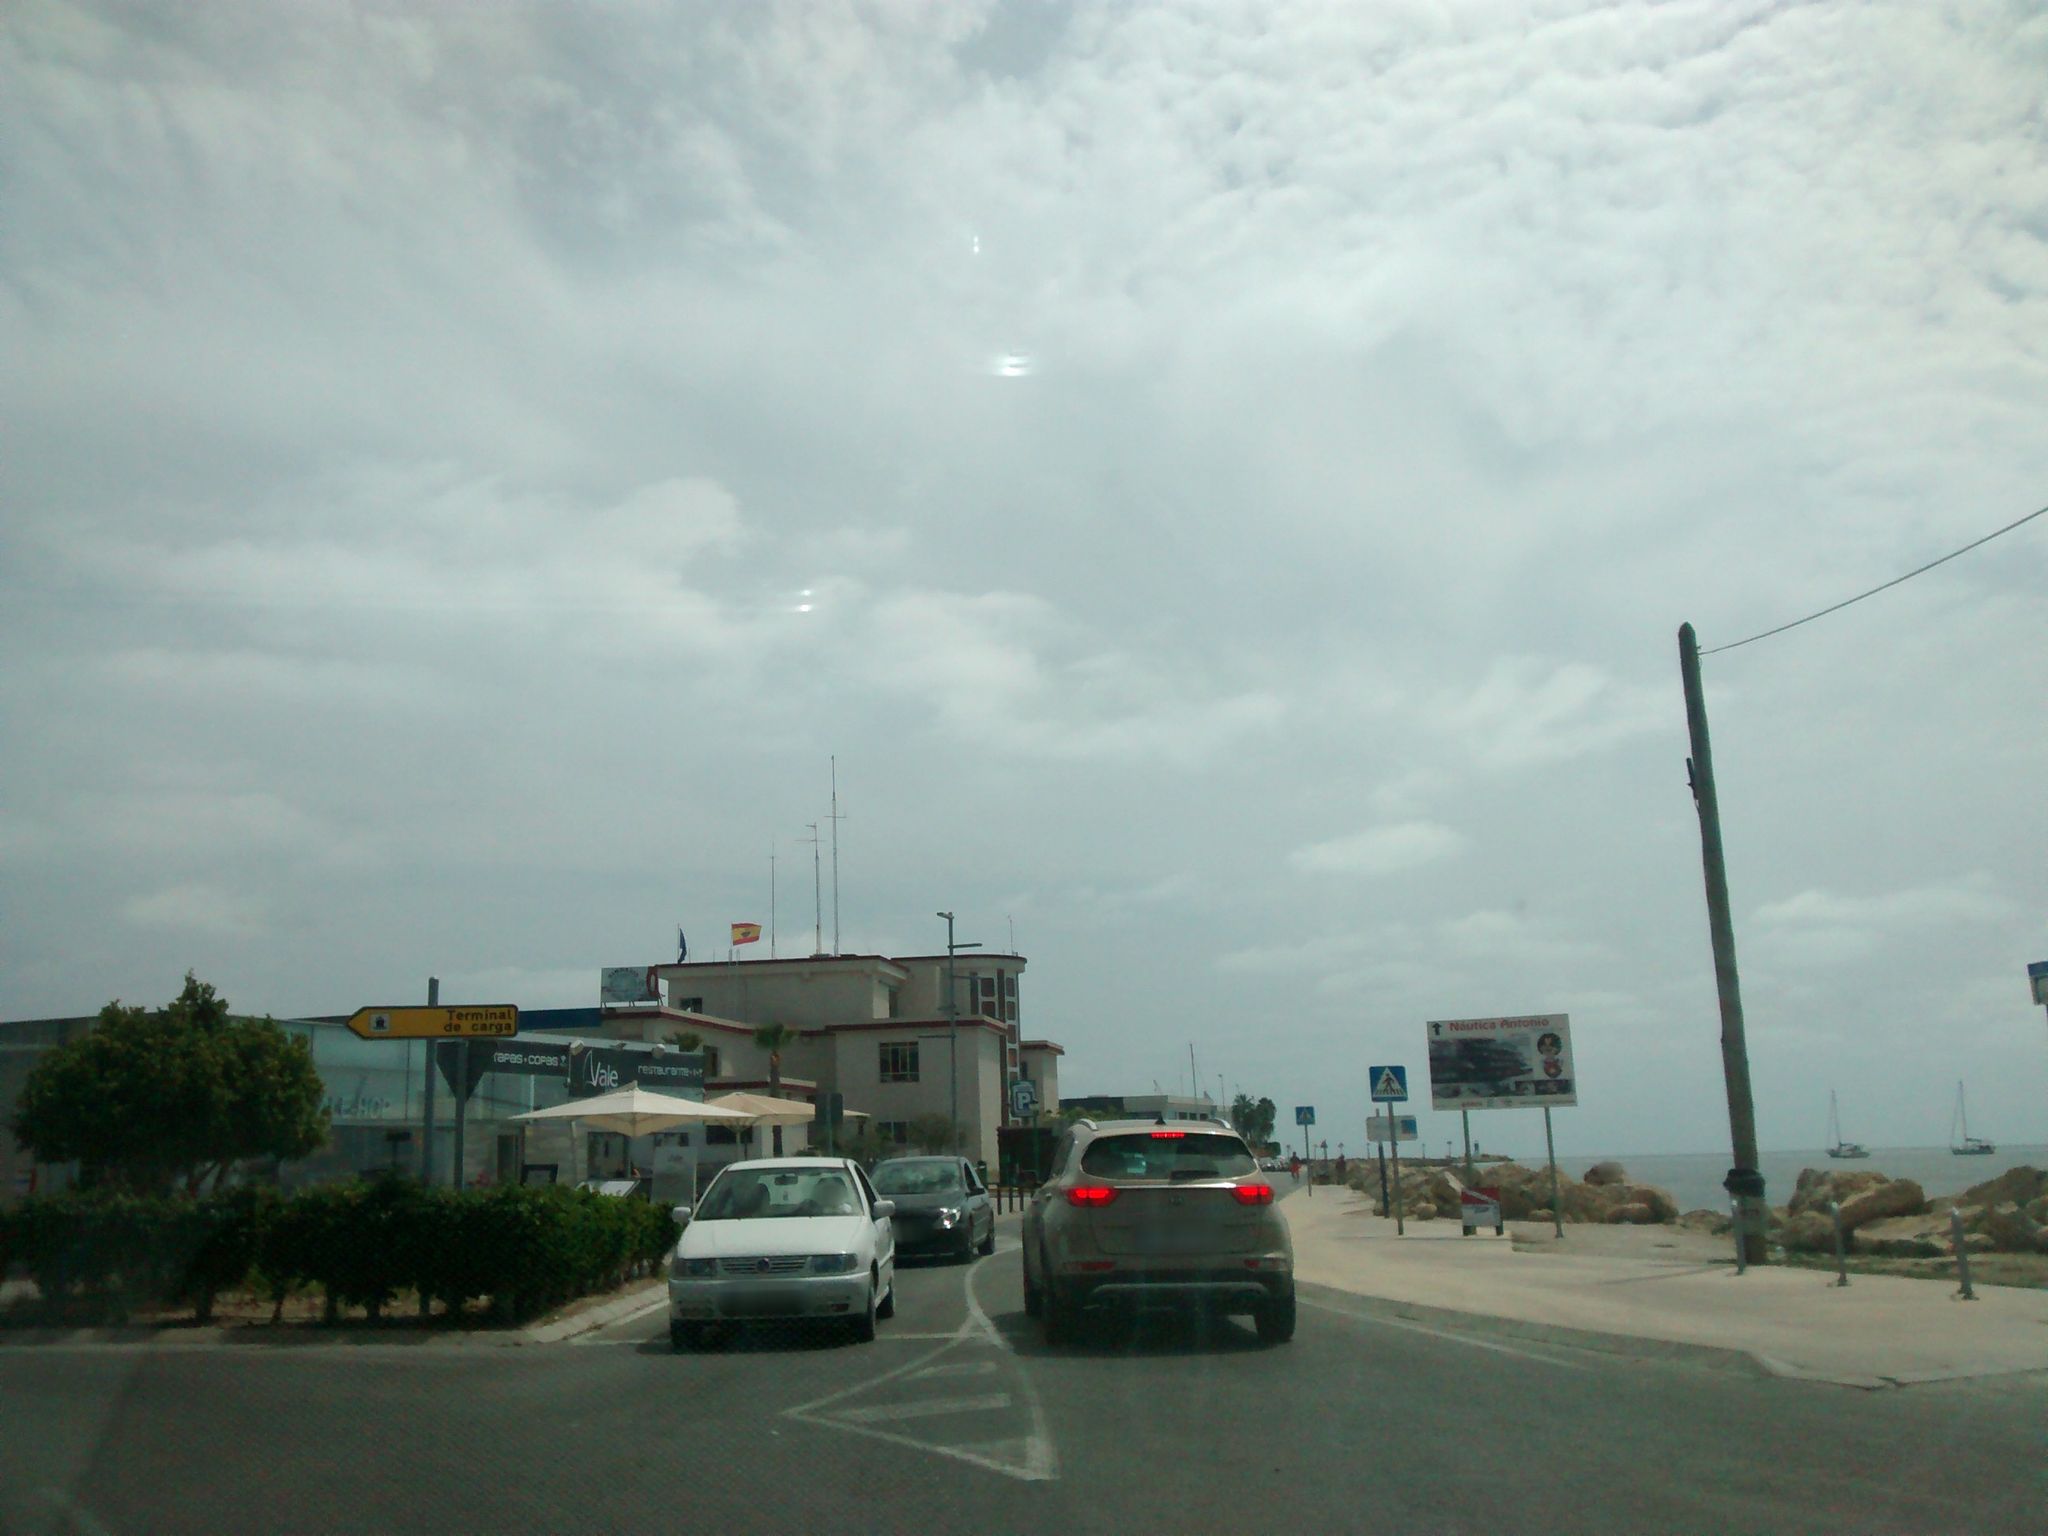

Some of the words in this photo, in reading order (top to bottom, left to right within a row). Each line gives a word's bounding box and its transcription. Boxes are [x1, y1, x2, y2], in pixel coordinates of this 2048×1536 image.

[447, 1009, 513, 1021] Terminal
[443, 1022, 461, 1033] de
[471, 1023, 512, 1034] carga
[1500, 1017, 1550, 1030] Antonio
[587, 1050, 619, 1087] Vale
[1017, 1092, 1031, 1110] P
